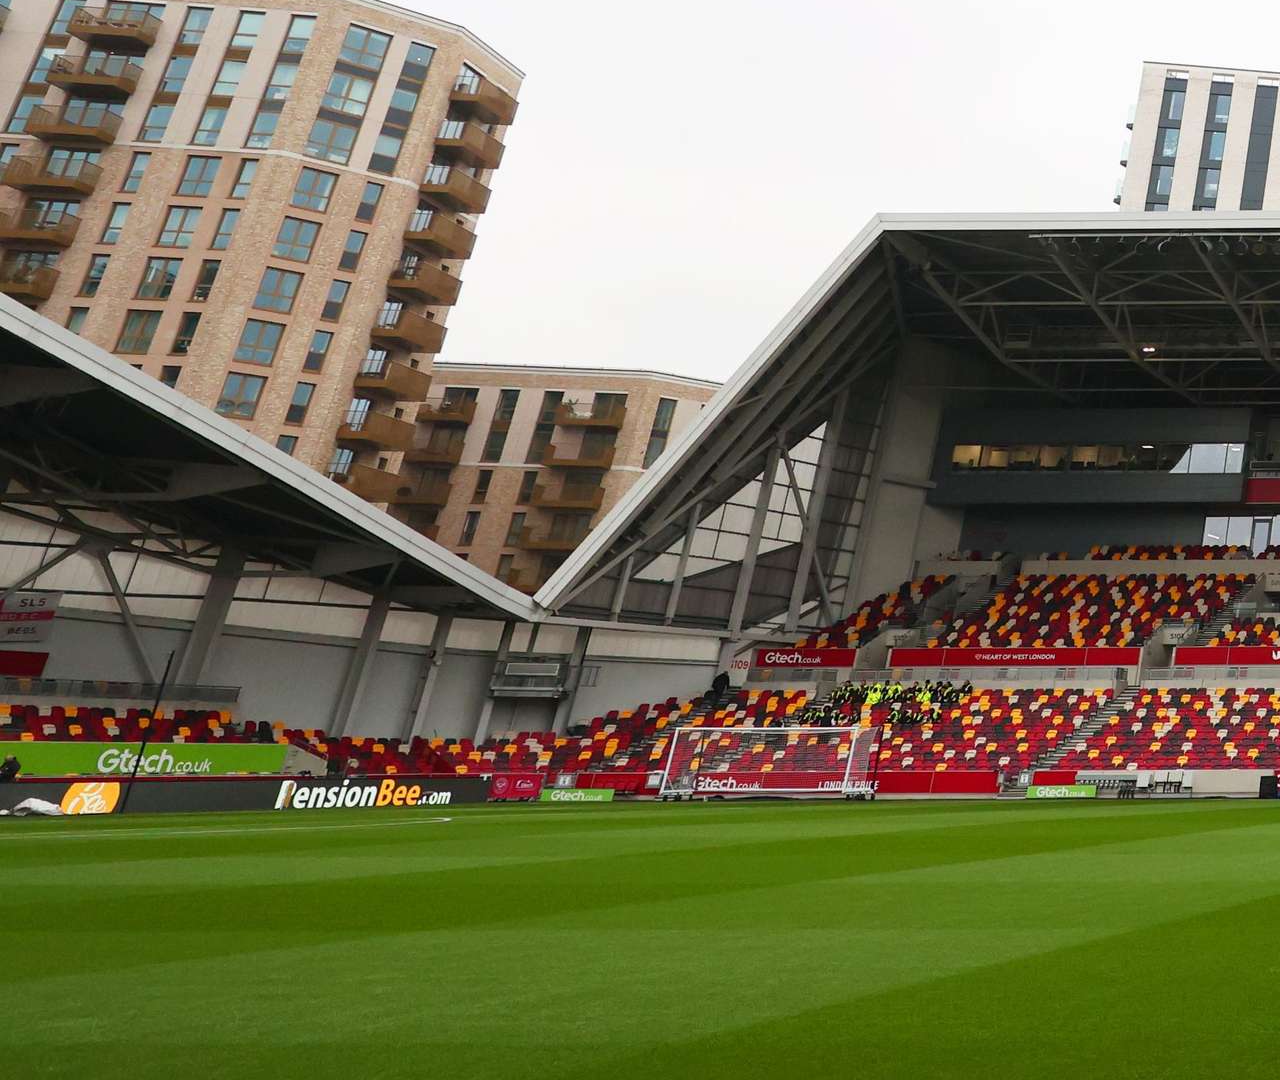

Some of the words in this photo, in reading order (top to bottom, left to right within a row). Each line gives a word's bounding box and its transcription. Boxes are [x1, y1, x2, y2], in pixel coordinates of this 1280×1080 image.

[765, 652, 821, 664] Gtech.co.uk
[97, 748, 212, 774] Gtech.co.uk
[694, 776, 760, 790] Gtech.co.uk
